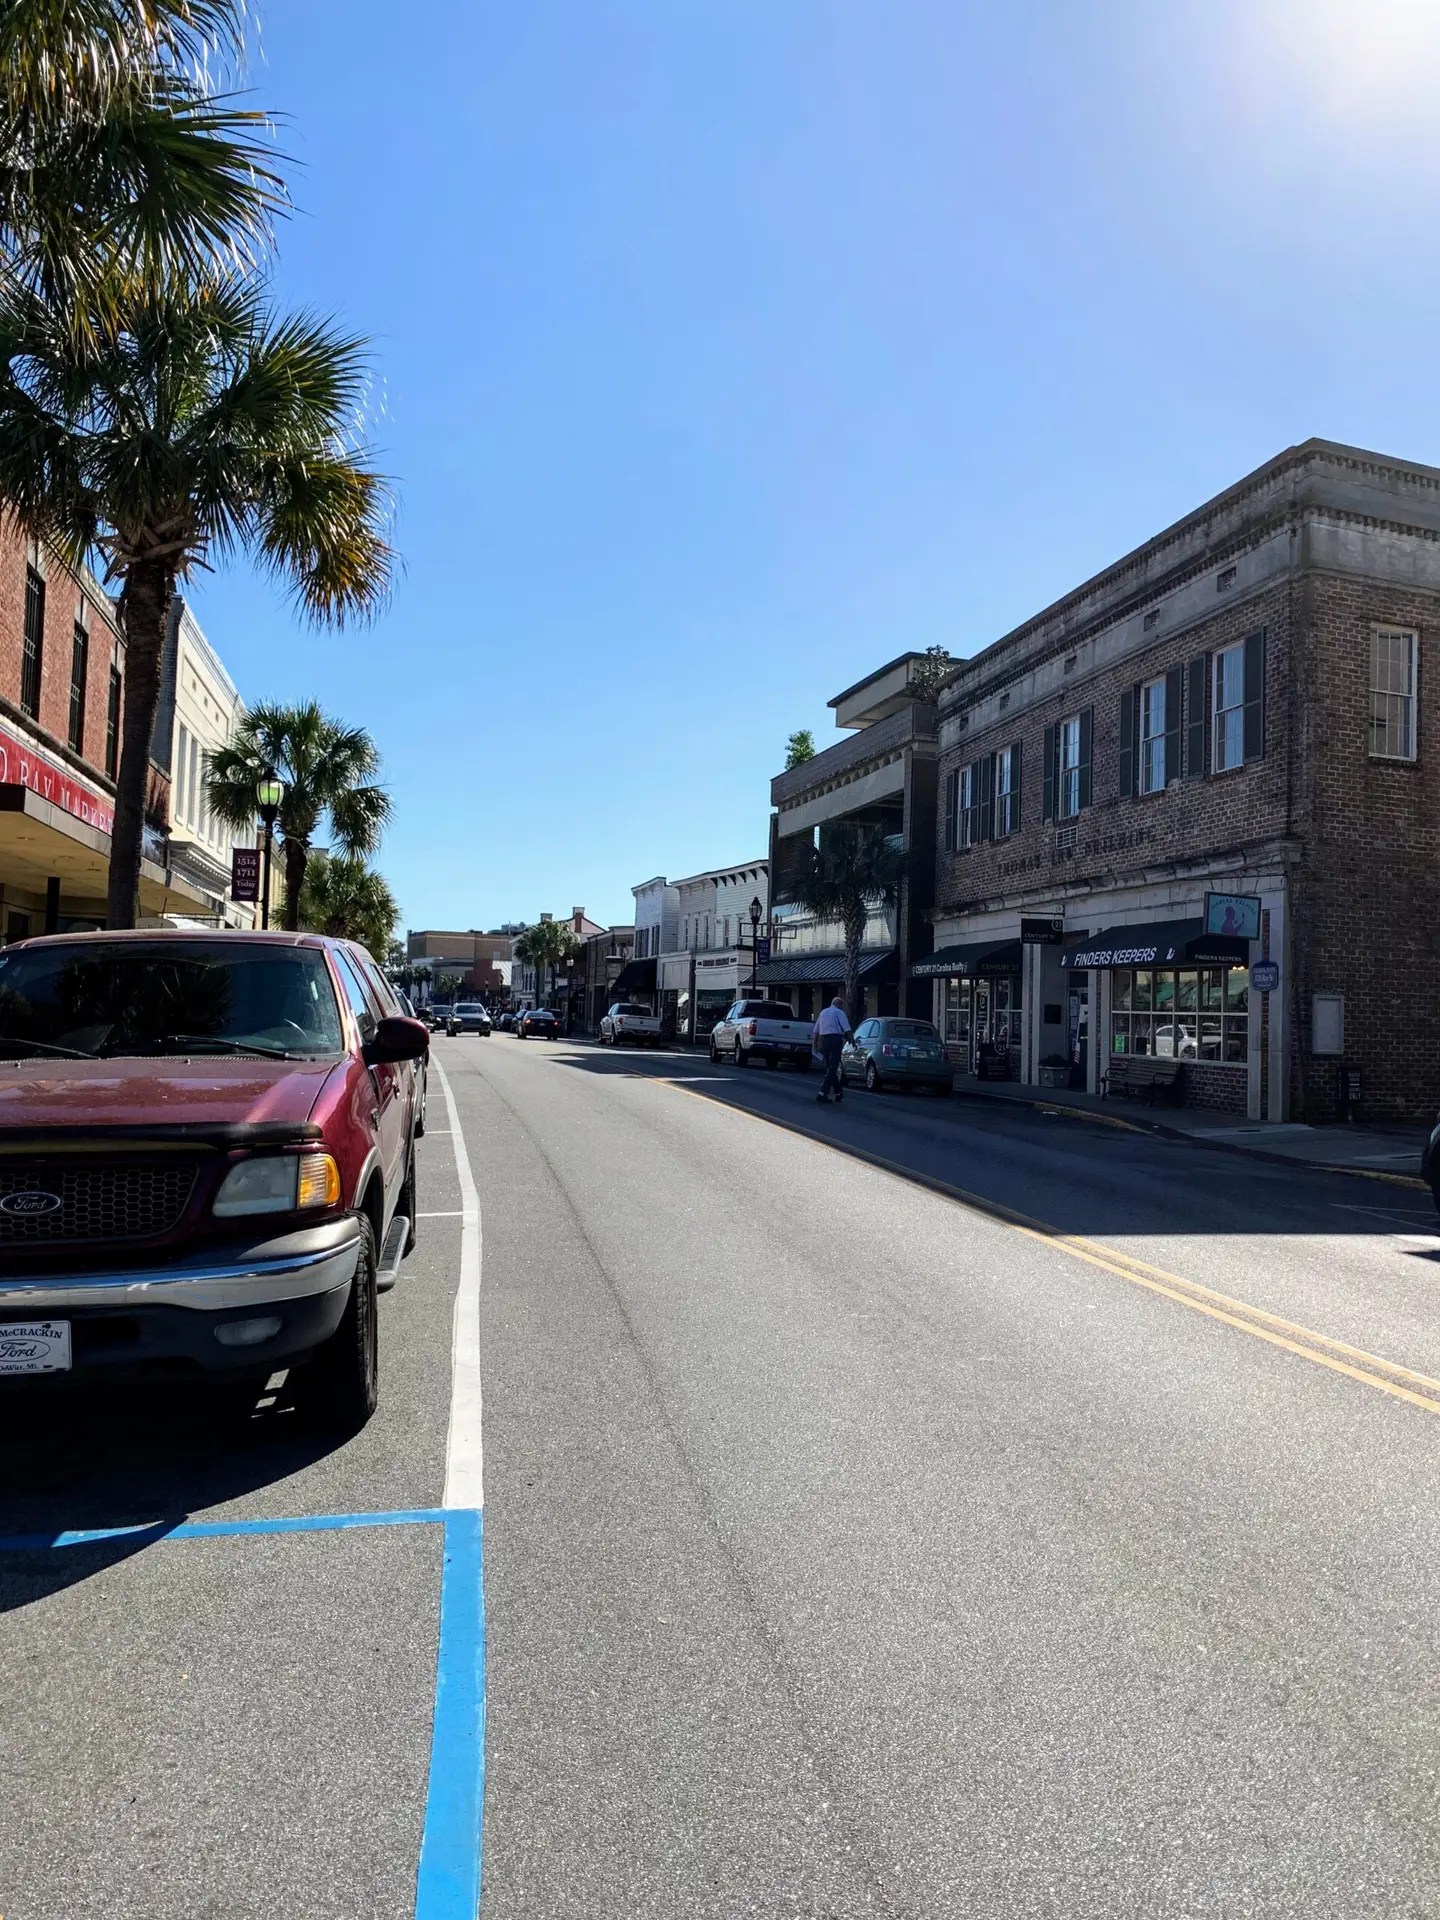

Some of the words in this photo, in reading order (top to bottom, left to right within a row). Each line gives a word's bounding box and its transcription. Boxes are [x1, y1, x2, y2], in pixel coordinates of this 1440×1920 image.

[20, 760, 52, 799] BAY
[237, 857, 256, 866] 1514
[237, 869, 256, 877] 1711
[236, 880, 256, 888] Today
[1074, 951, 1113, 967] FINDERS
[1111, 946, 1157, 965] KEEPERS
[1195, 953, 1218, 962] FINDERS
[1218, 955, 1242, 963] KEEPERS
[915, 965, 932, 974] CENTURY
[937, 963, 951, 973] Carolina
[952, 962, 964, 974] Realty
[14, 1196, 47, 1210] Ford
[0, 1328, 63, 1339] McCRACKIN
[0, 1342, 37, 1358] Ford
